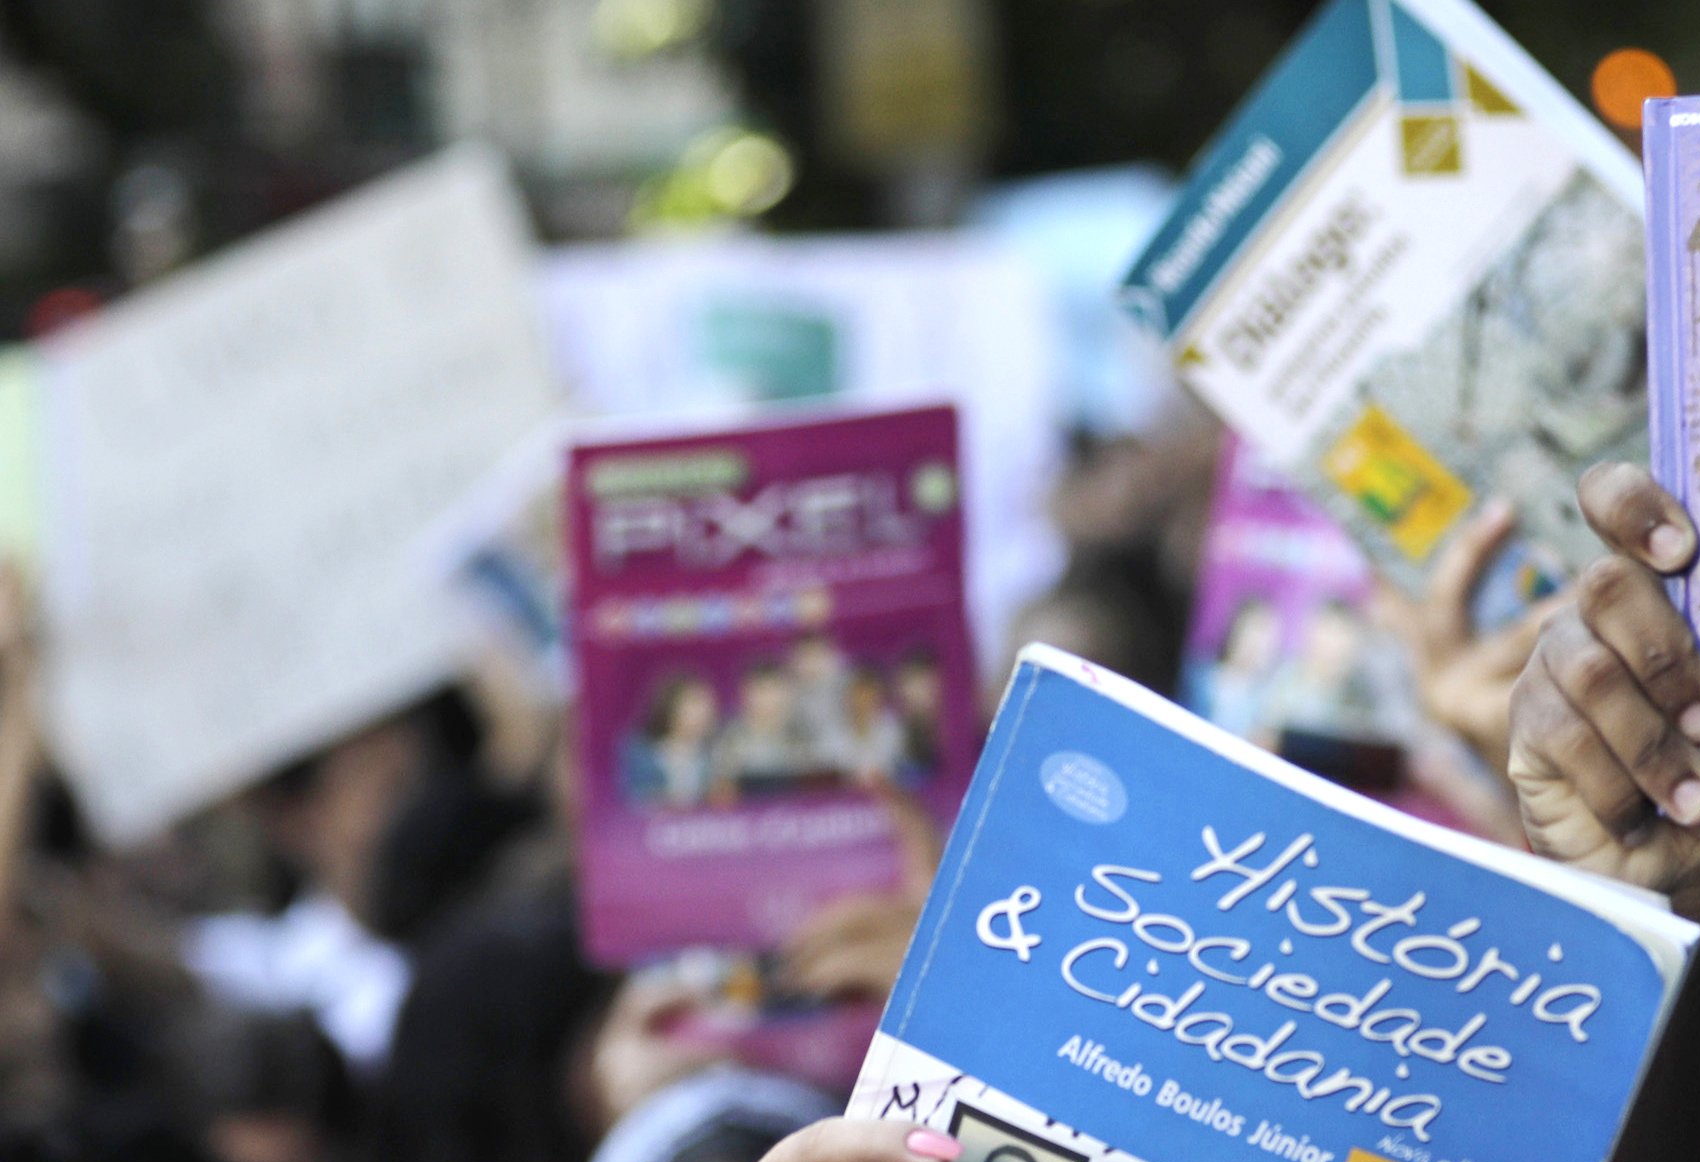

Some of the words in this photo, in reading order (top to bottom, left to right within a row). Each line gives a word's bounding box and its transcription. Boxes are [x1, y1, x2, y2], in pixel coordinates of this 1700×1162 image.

[975, 885, 1042, 963] &
[1060, 936, 1443, 1144] Cidadania
[1073, 864, 1513, 1084] Sociedade
[1190, 825, 1602, 1044] História
[1056, 1034, 1153, 1097] Alfredo
[1155, 1078, 1247, 1138] Boulos
